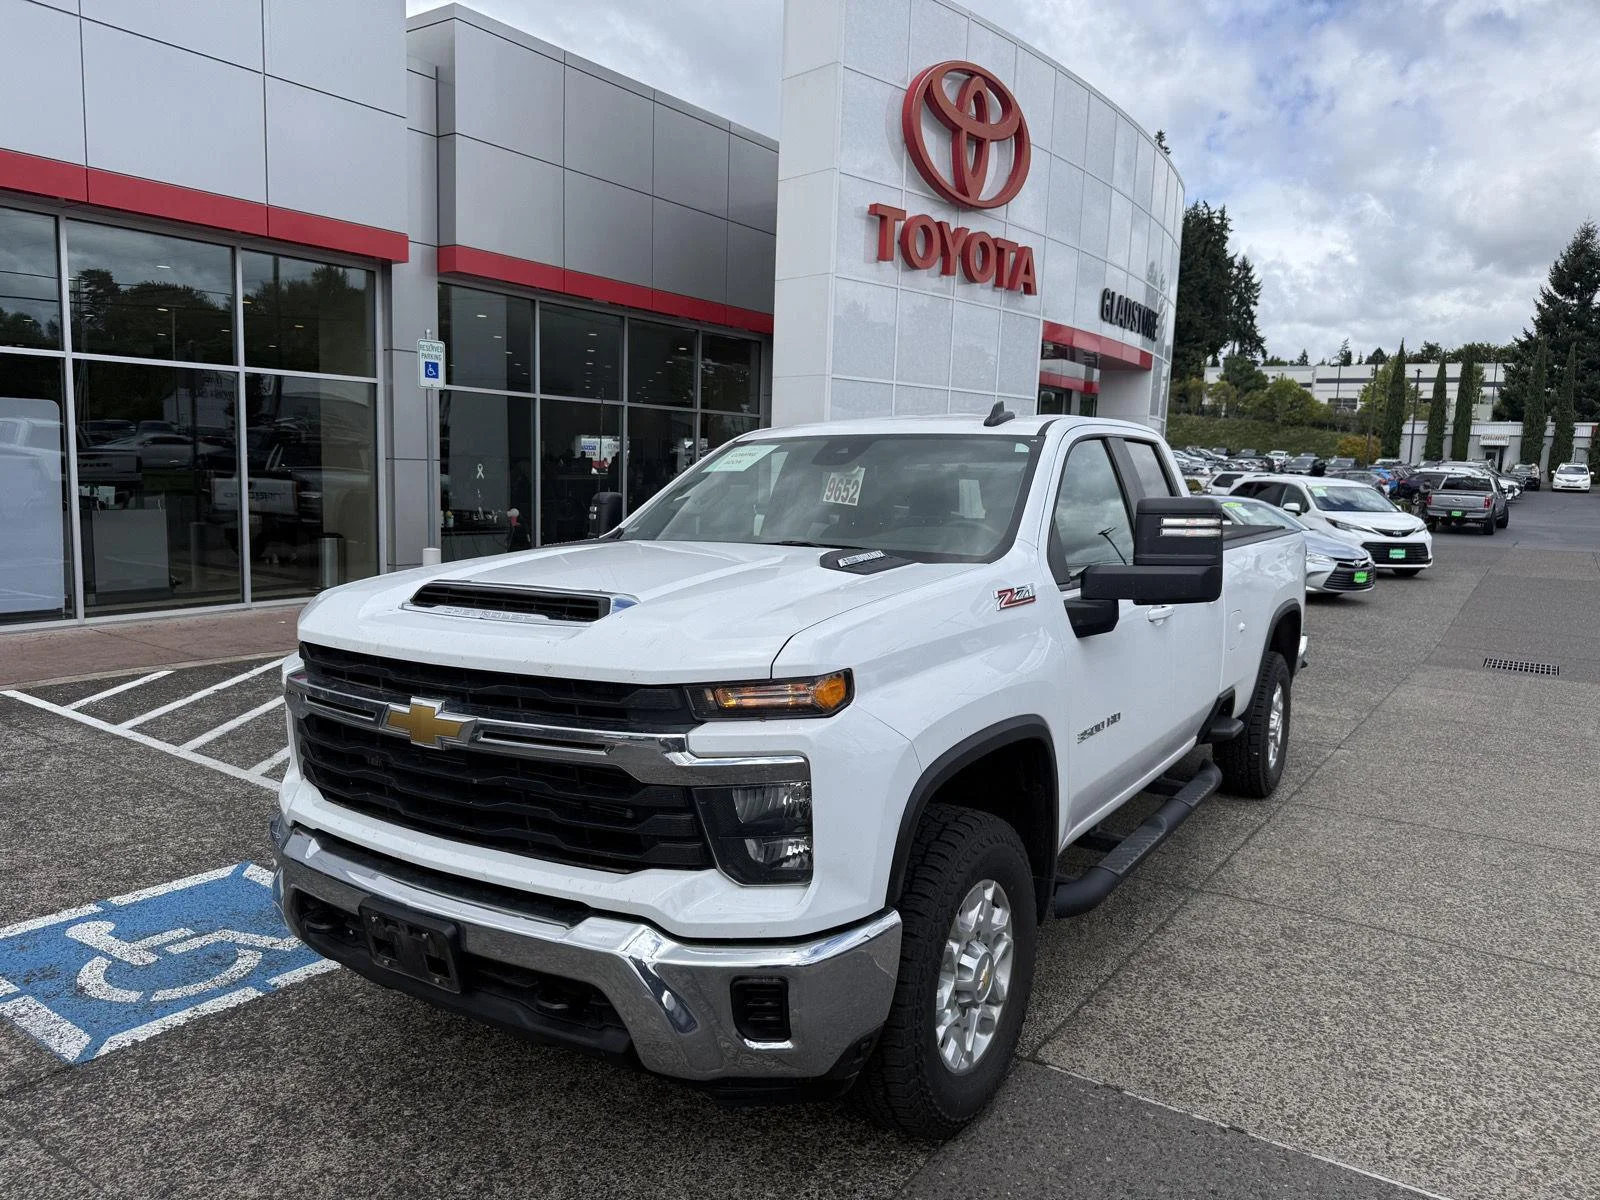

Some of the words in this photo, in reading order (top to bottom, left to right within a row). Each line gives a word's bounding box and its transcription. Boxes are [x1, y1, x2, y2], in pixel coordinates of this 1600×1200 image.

[868, 203, 1037, 295] TOYOTA
[1100, 288, 1159, 341] GLADSTONE
[420, 343, 443, 353] RESERVED
[421, 353, 442, 361] PARKING
[824, 477, 860, 504] 9652
[993, 583, 1036, 611] Z71
[1077, 720, 1105, 744] 3500
[1106, 712, 1121, 728] HD
